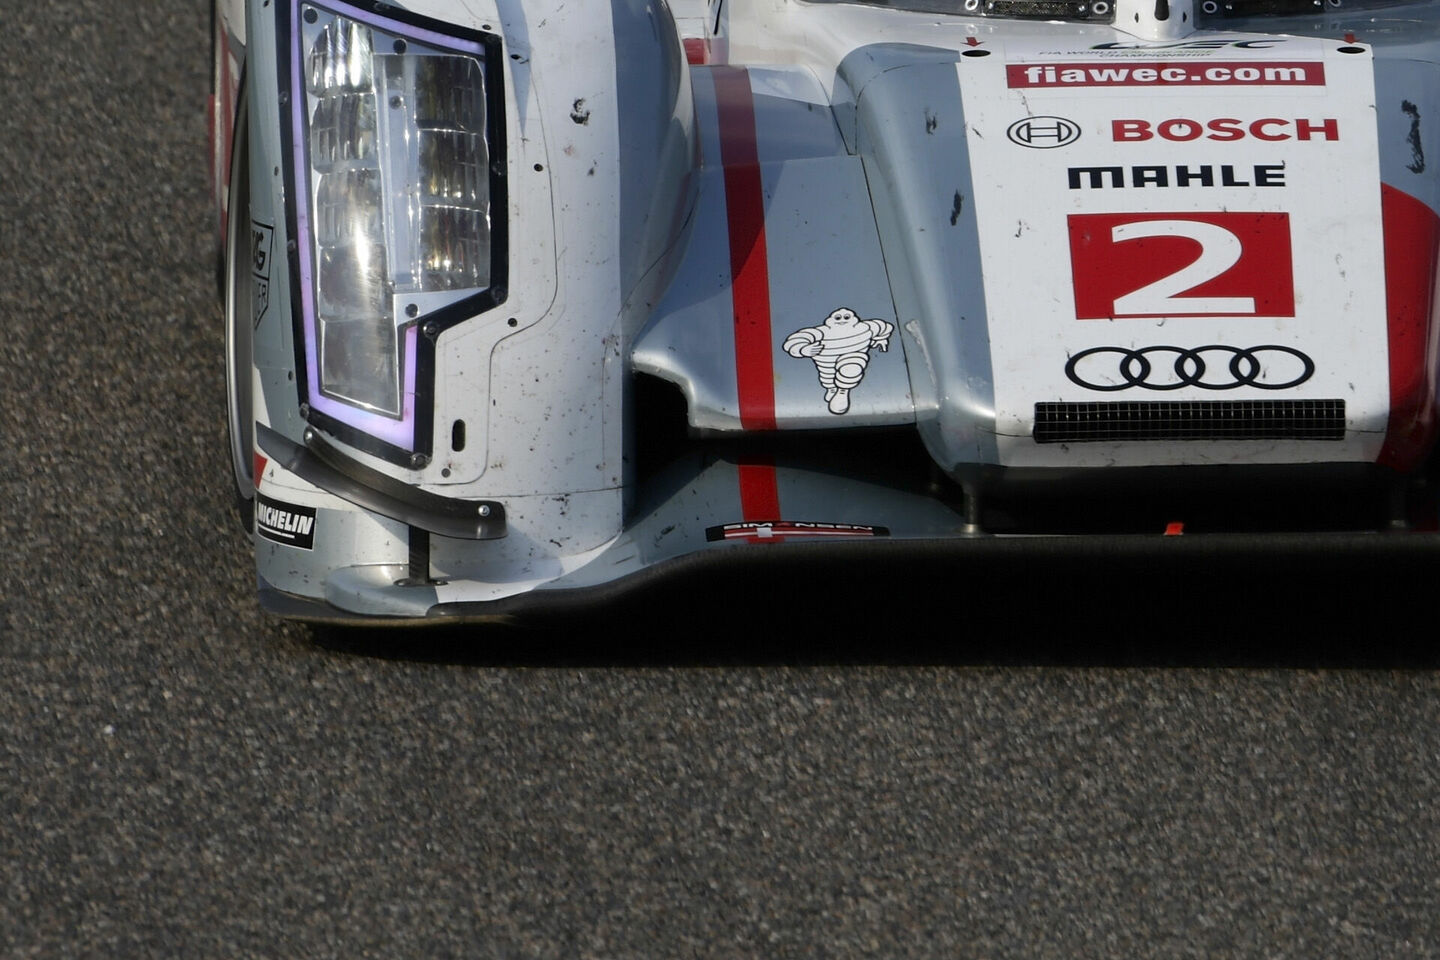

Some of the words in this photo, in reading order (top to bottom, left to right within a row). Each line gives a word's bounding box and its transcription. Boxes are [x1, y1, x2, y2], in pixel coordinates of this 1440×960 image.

[1024, 65, 1306, 83] fiawec.com
[1111, 117, 1340, 142] BOSCH
[1068, 164, 1286, 190] MAHLE
[1110, 218, 1256, 316] 2
[258, 501, 314, 536] MICHELIN
